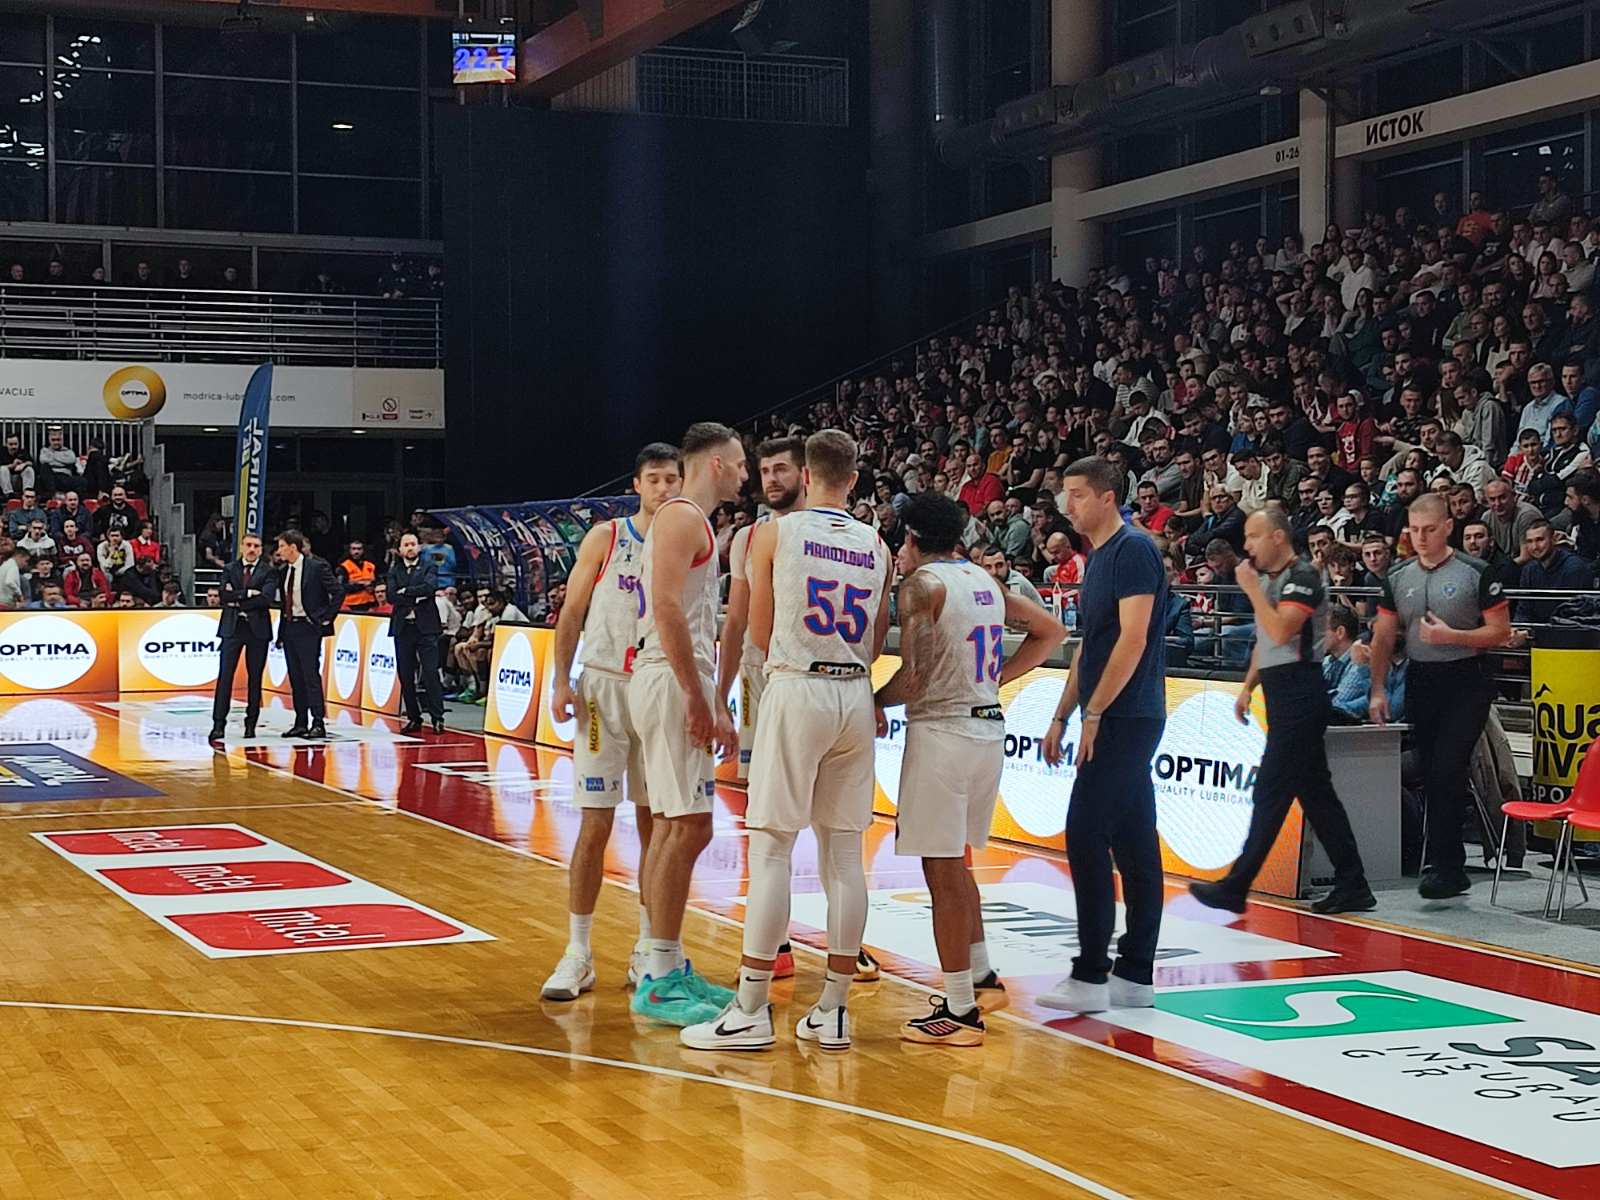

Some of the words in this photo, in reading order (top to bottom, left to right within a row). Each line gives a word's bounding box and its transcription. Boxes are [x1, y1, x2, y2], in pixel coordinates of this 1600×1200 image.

[454, 47, 514, 70] 22.7
[1366, 110, 1424, 146] ИСТОК
[121, 389, 148, 397] OPTIMA
[803, 575, 873, 644] 55
[0, 643, 89, 656] OPTIMA
[498, 668, 532, 687] OPTIMA
[1155, 753, 1260, 791] OPTIMA
[1385, 1045, 1600, 1114] INSURA
